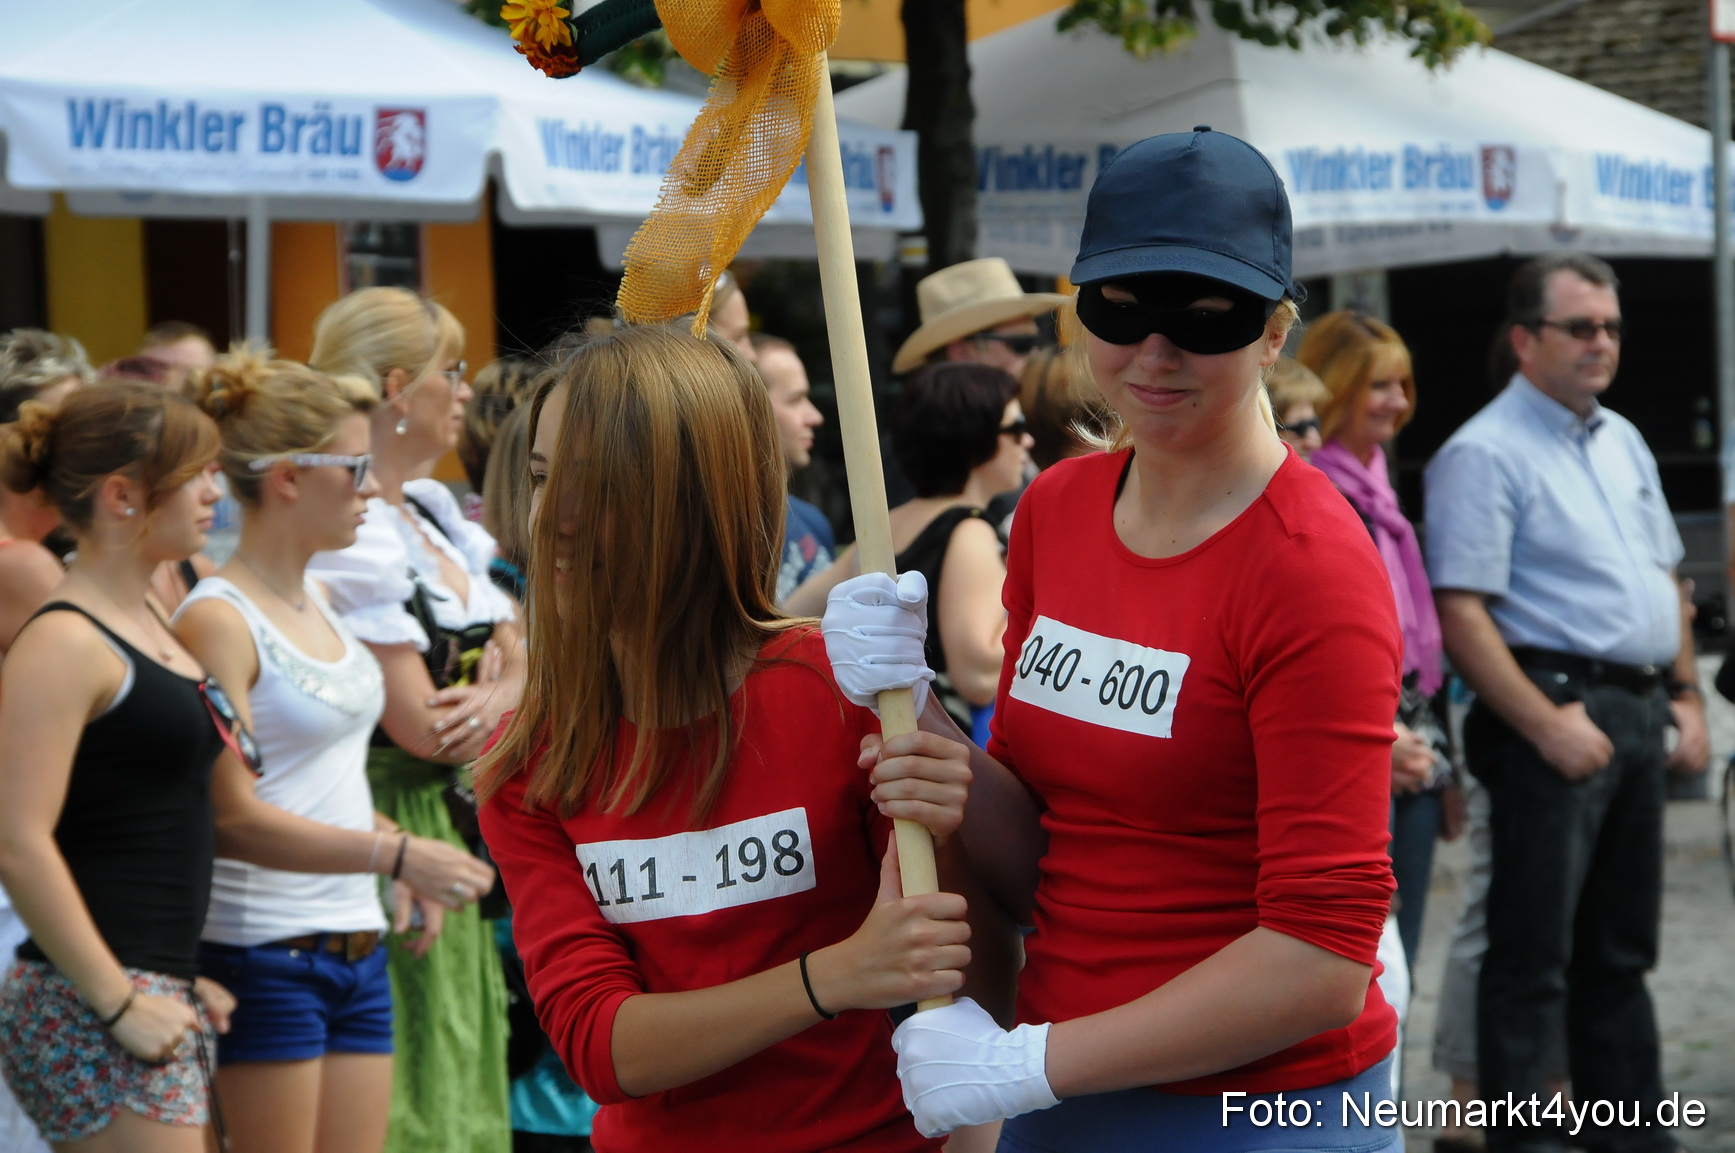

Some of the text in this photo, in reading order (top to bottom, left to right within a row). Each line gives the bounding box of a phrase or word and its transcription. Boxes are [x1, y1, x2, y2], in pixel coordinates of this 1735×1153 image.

[66, 98, 363, 156] Winkler Bräu
[536, 117, 625, 174] Winkler
[1284, 143, 1475, 192] Winkler Bräu
[1595, 153, 1695, 206] Winkler
[1020, 635, 1081, 692] 040
[1099, 659, 1169, 715] 600
[586, 857, 664, 907] 111
[715, 829, 805, 890] 198
